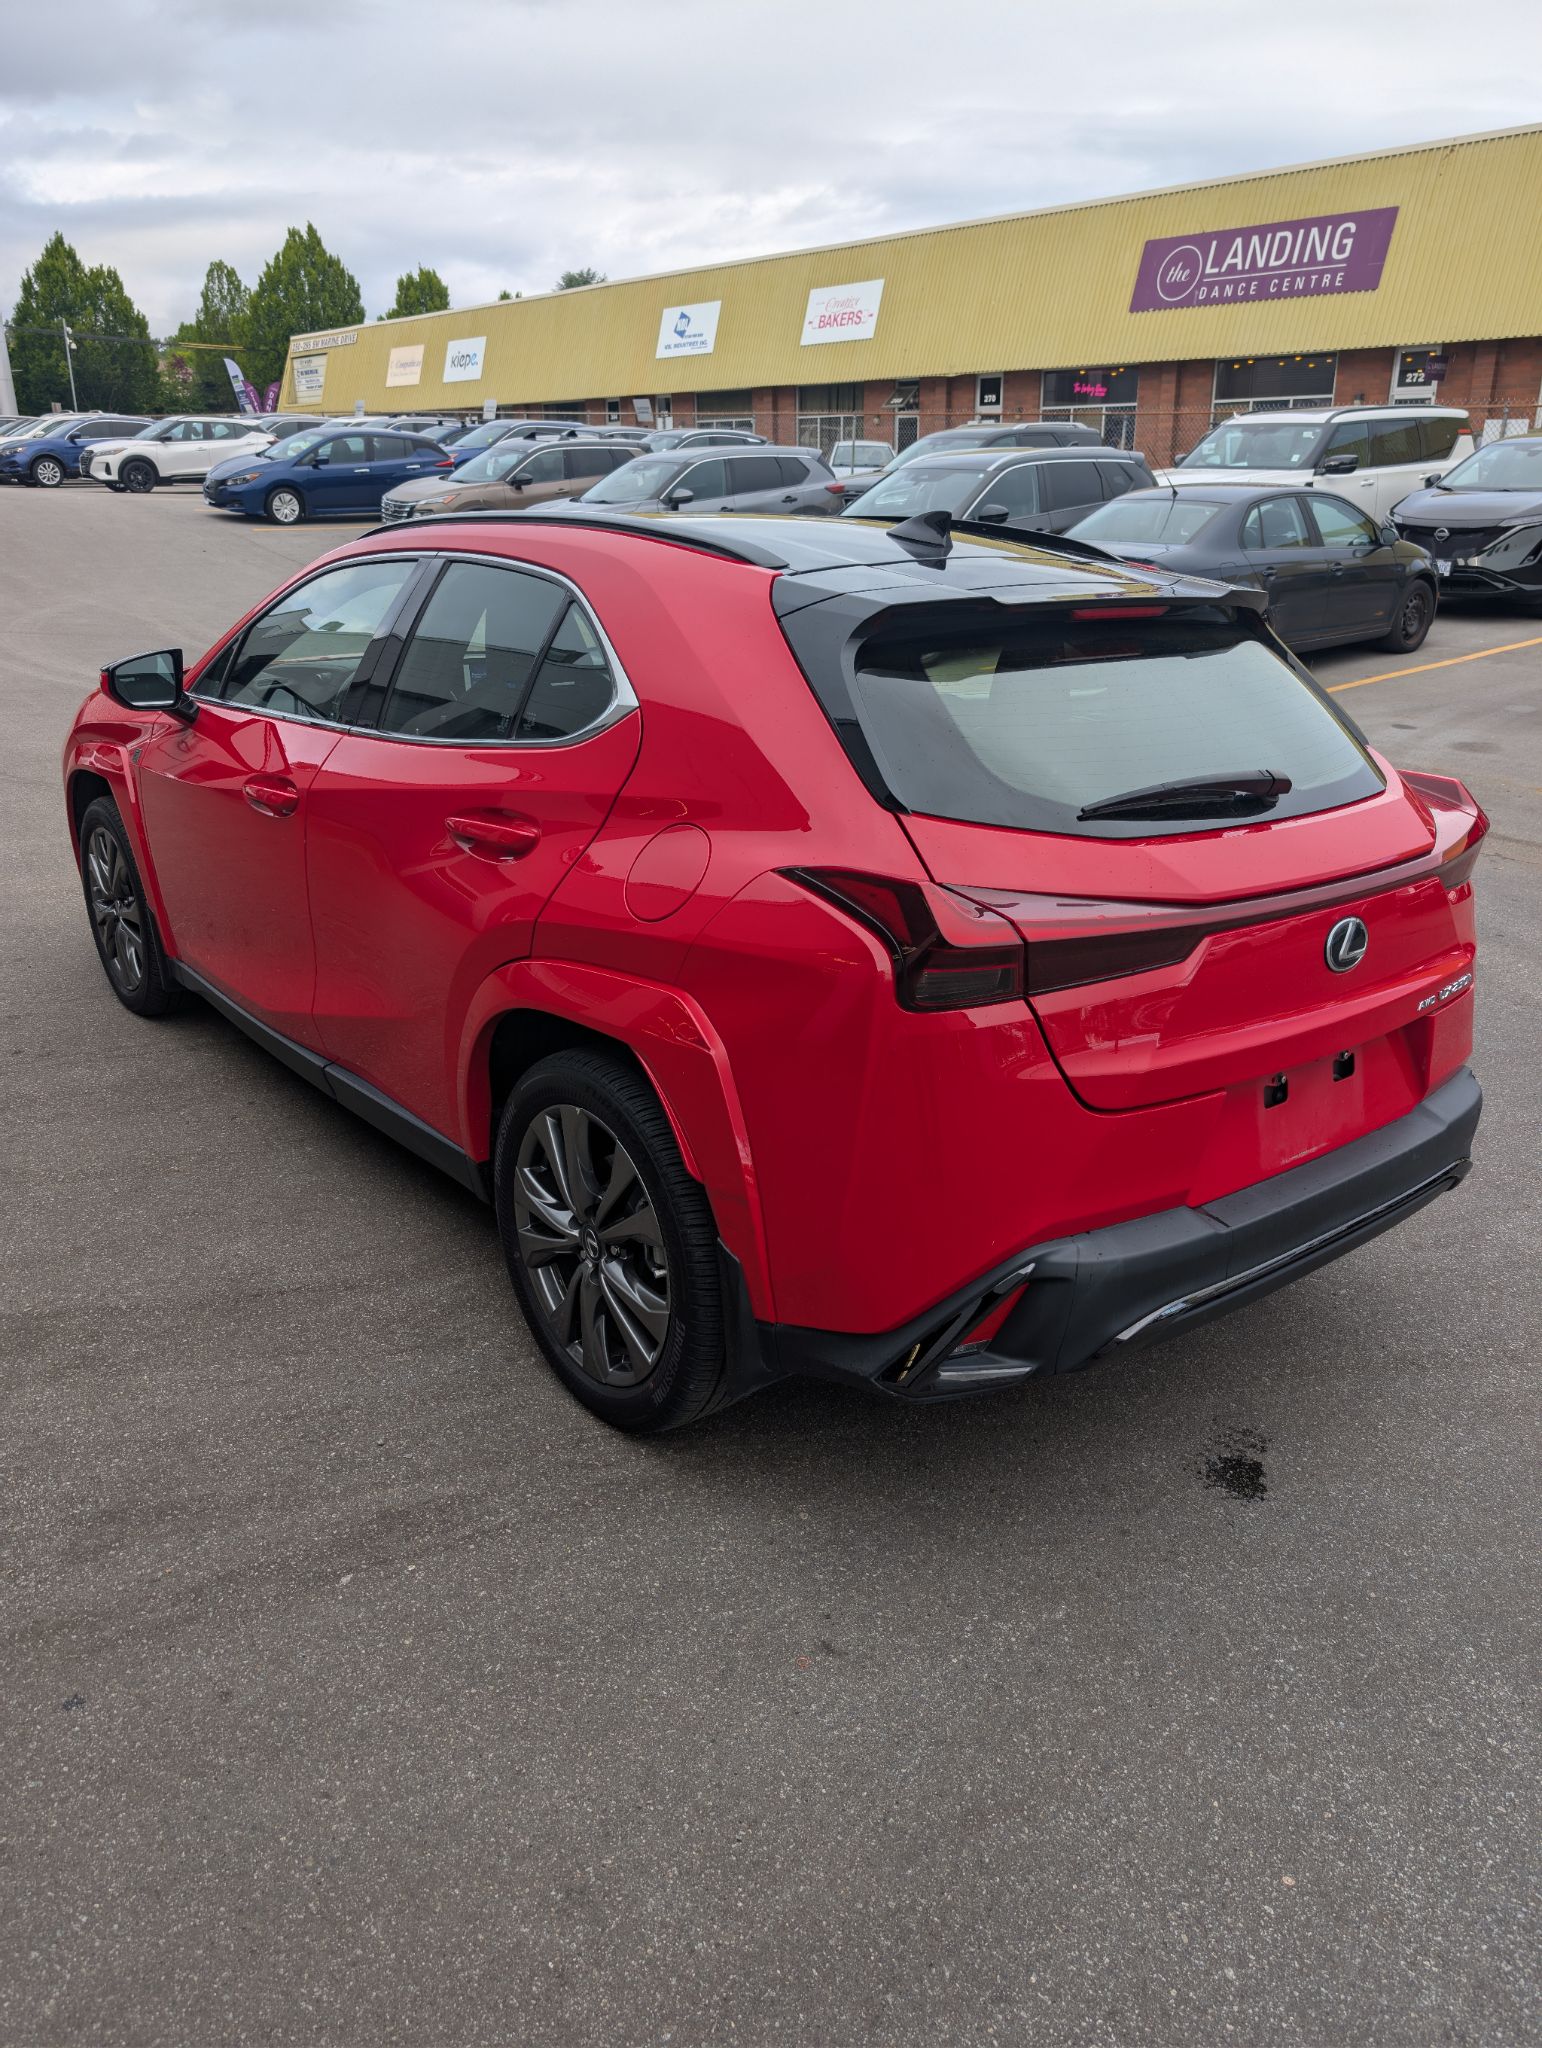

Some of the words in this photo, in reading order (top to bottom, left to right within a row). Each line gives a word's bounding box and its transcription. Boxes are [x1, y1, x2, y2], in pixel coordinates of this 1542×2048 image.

[1205, 222, 1357, 275] LANDING
[1166, 261, 1191, 284] the
[1198, 281, 1259, 300] DANCE
[1270, 272, 1345, 293] CENTRE
[818, 310, 863, 329] BAKERS
[1405, 372, 1425, 383] 272
[984, 394, 997, 403] 270
